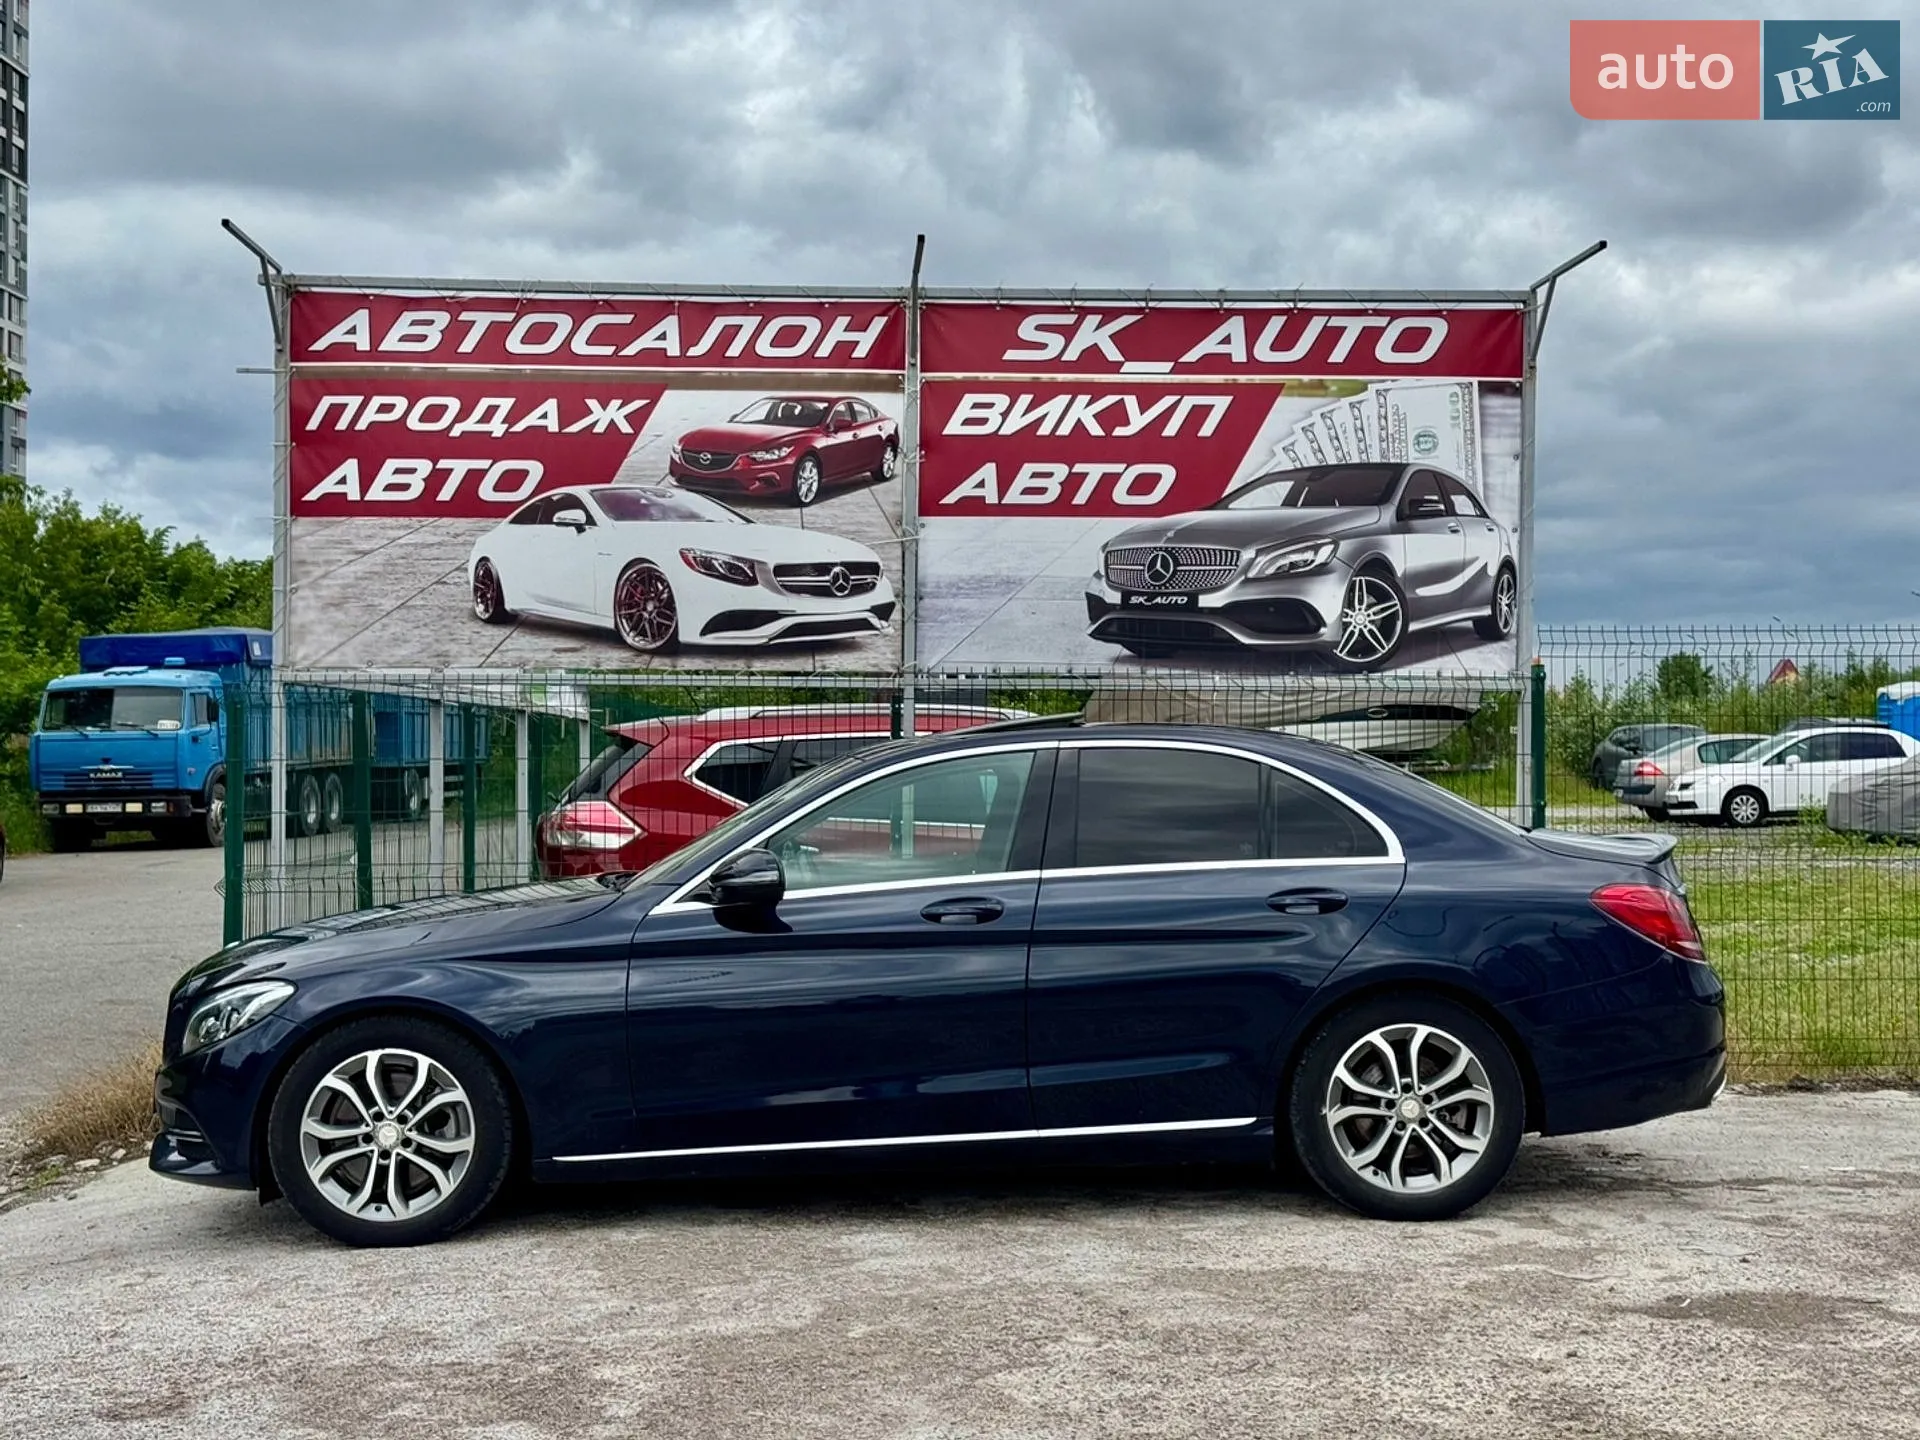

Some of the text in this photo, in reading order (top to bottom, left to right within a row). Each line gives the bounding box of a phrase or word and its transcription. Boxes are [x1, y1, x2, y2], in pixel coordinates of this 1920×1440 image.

[307, 308, 889, 359] АВТОСАЛОН
[1001, 313, 1449, 374] SK_AUTO
[305, 395, 651, 438] ПРОДАЖ
[941, 393, 1234, 437] ВИКУП
[301, 458, 545, 502] АВТО
[938, 462, 1177, 506] АВТО
[1129, 595, 1188, 605] SK_AUTO
